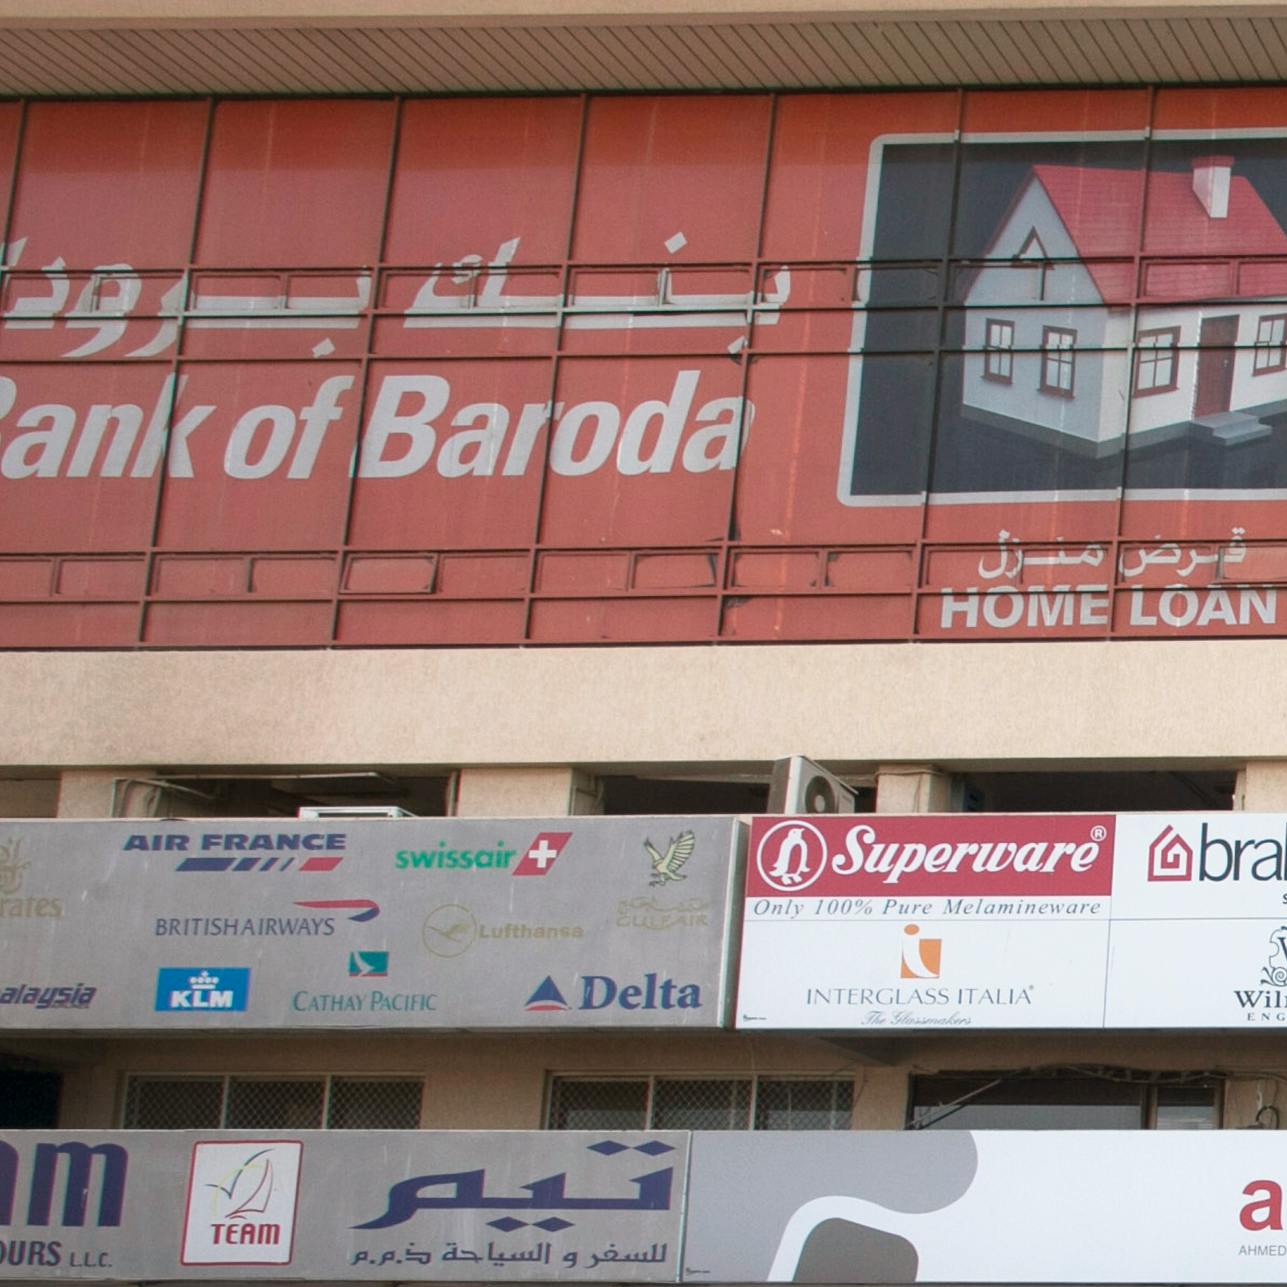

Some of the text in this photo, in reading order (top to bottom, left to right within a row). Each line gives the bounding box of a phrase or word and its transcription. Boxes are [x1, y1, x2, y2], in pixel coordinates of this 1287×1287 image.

[0, 370, 756, 479] ank of Baroda
[1118, 527, 1247, 577] قرض
[940, 583, 1278, 628] HOME LOAN
[124, 833, 346, 851] AIR FRANCE
[395, 840, 516, 869] swissair
[832, 825, 1100, 883] Superware
[754, 899, 1101, 919] Only 100% Pure Melamineware
[478, 922, 584, 941] Lufthansa
[0, 983, 97, 1009] alaysia
[170, 990, 234, 1008] KLM
[293, 990, 438, 1012] CATHAY PACIFIC
[578, 974, 702, 1010] Delta
[807, 988, 1029, 1006] INTERGLASS ITALIA
[861, 1010, 972, 1026] The Glassmakers
[348, 1140, 677, 1232] تيم
[211, 1223, 280, 1245] TEAM
[441, 1242, 550, 1266] السياحة
[562, 1252, 577, 1267] و
[587, 1243, 667, 1268] للسفر
[1238, 1245, 1287, 1257] AHMED
